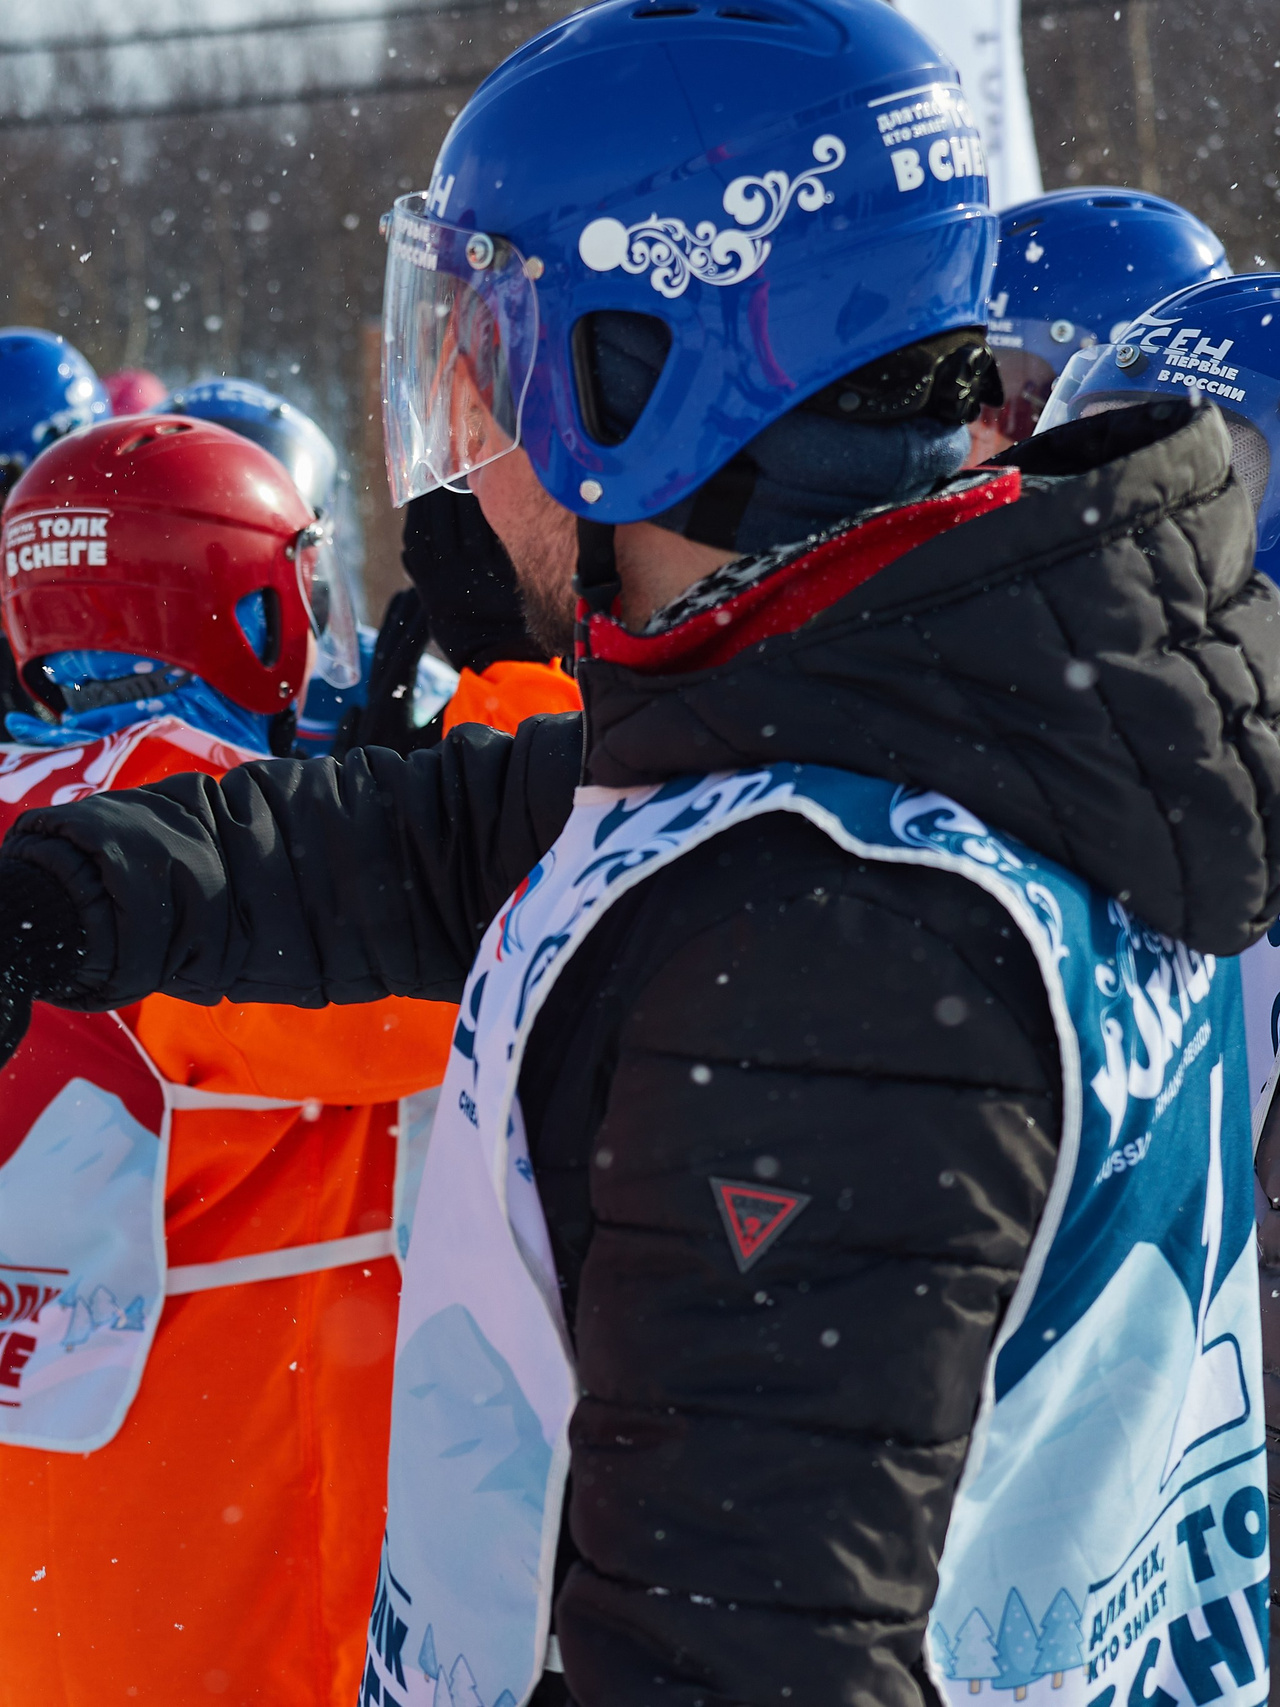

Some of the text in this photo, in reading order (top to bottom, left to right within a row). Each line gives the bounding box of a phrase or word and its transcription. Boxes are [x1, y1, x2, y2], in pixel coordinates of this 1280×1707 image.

[890, 147, 926, 193] В
[1165, 353, 1240, 381] ПЕРВЫЕ
[1157, 369, 1246, 402] В РОССИИ
[38, 516, 109, 539] ТОЛК
[19, 540, 108, 572] СНЕГЕ
[1086, 1634, 1120, 1686] КТО
[1123, 1579, 1168, 1650] ЗНАЕТ
[1089, 1581, 1128, 1652] ДЛЯ
